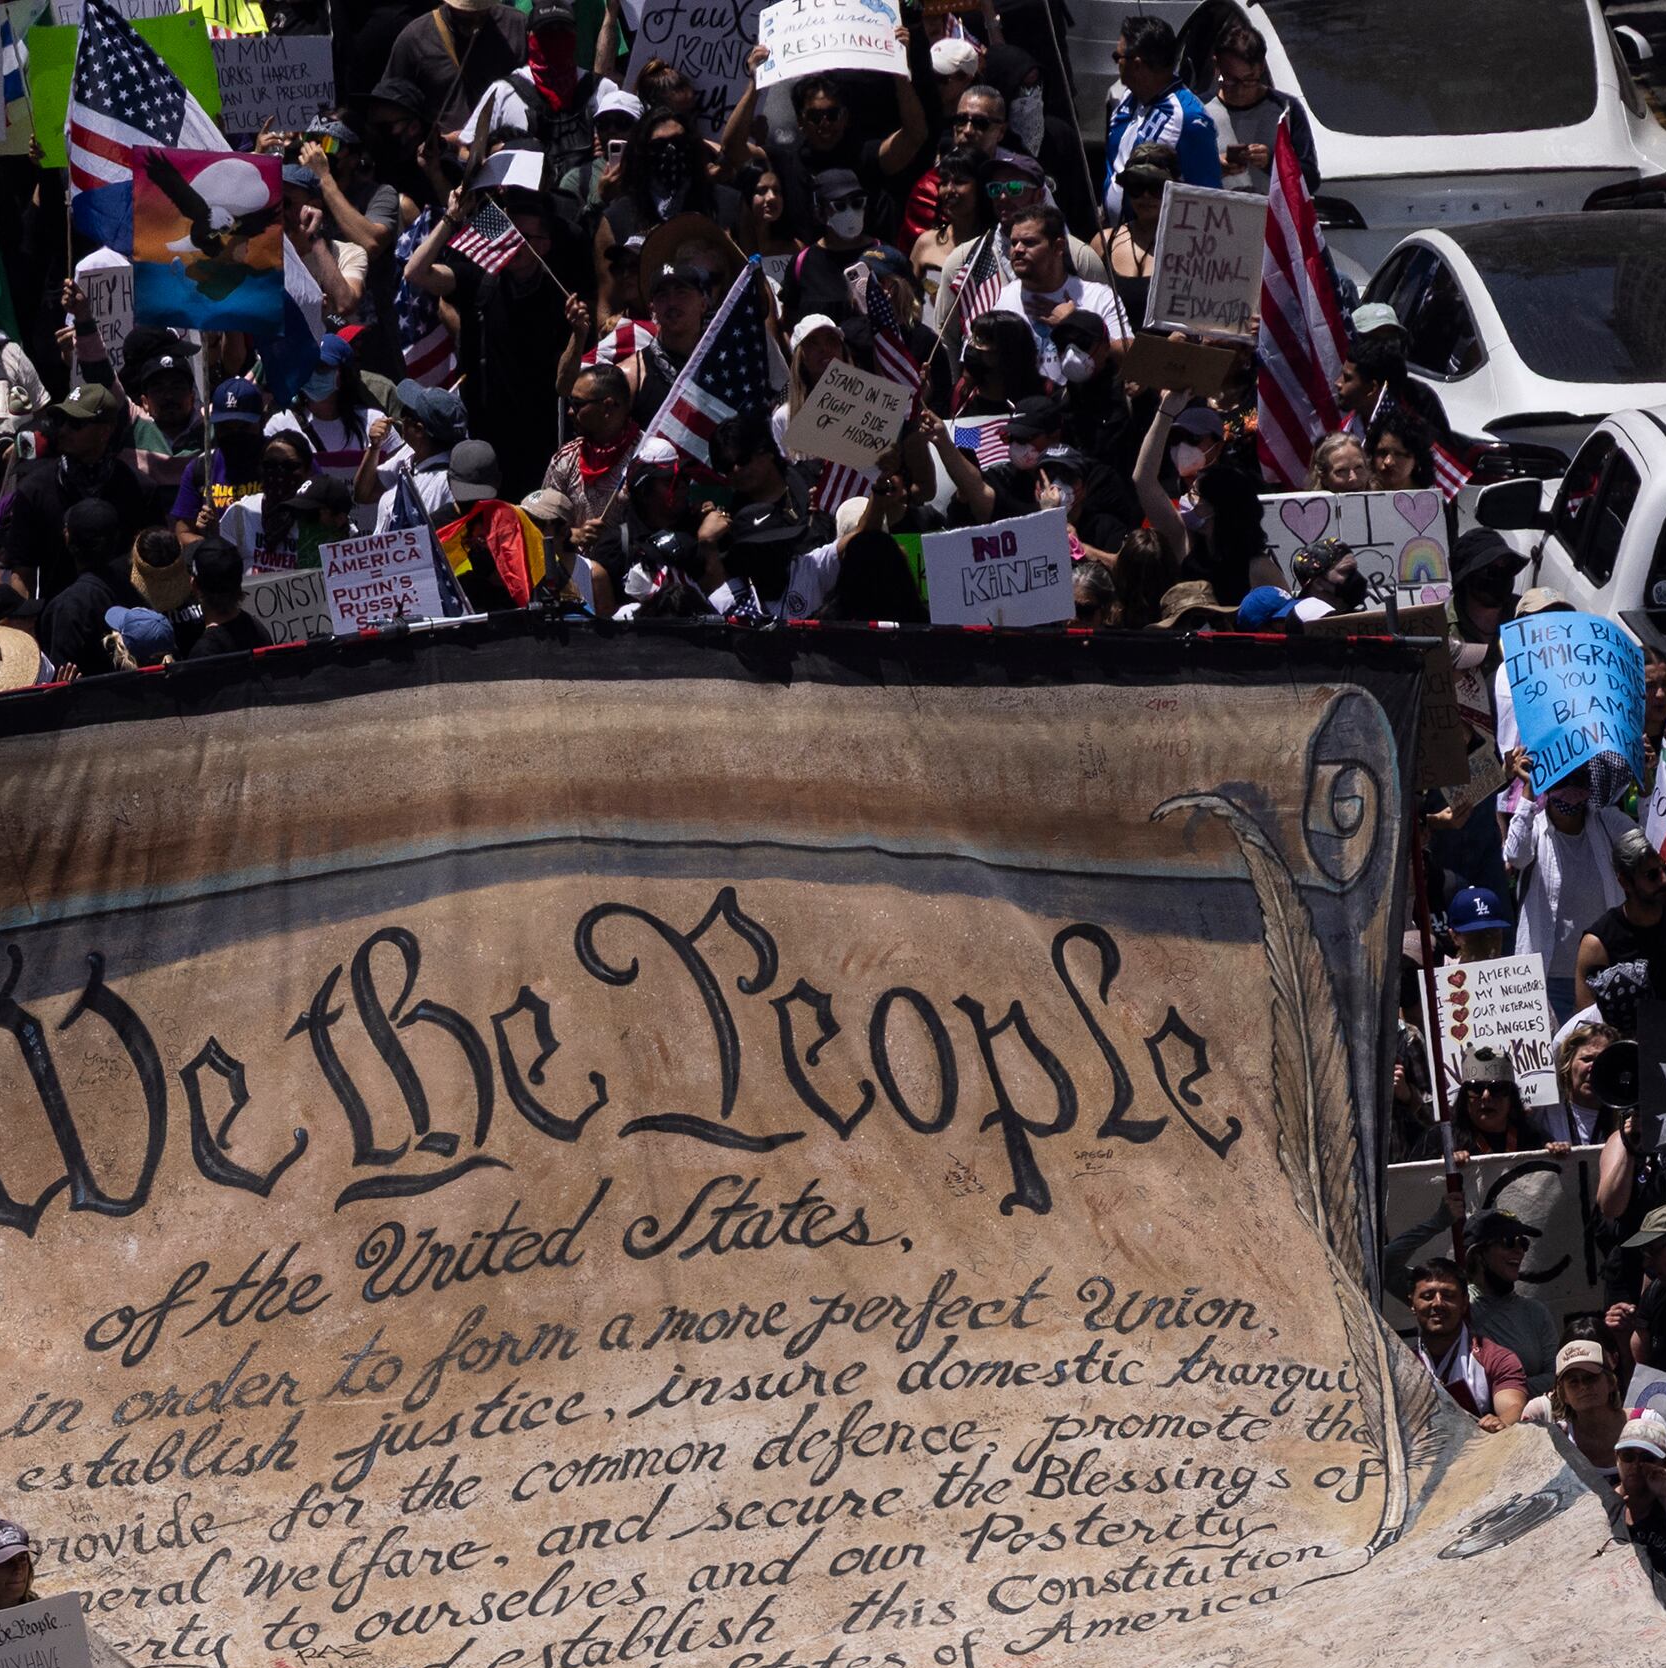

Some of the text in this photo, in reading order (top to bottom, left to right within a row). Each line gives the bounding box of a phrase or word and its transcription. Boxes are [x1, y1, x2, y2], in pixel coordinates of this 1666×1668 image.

[817, 392, 888, 432] RIGHT SIDE
[817, 414, 891, 453] OF HISTORY
[825, 368, 901, 412] STAND ON THE
[286, 926, 607, 1212] the
[575, 886, 1241, 1216] People
[84, 1174, 914, 1368] of the United States,
[112, 1340, 312, 1428] order
[321, 1328, 403, 1398] to
[402, 1304, 580, 1413] form
[599, 1311, 635, 1352] a
[641, 1302, 791, 1352] more
[783, 1266, 1055, 1359] perfect
[1076, 1275, 1282, 1339] Union,
